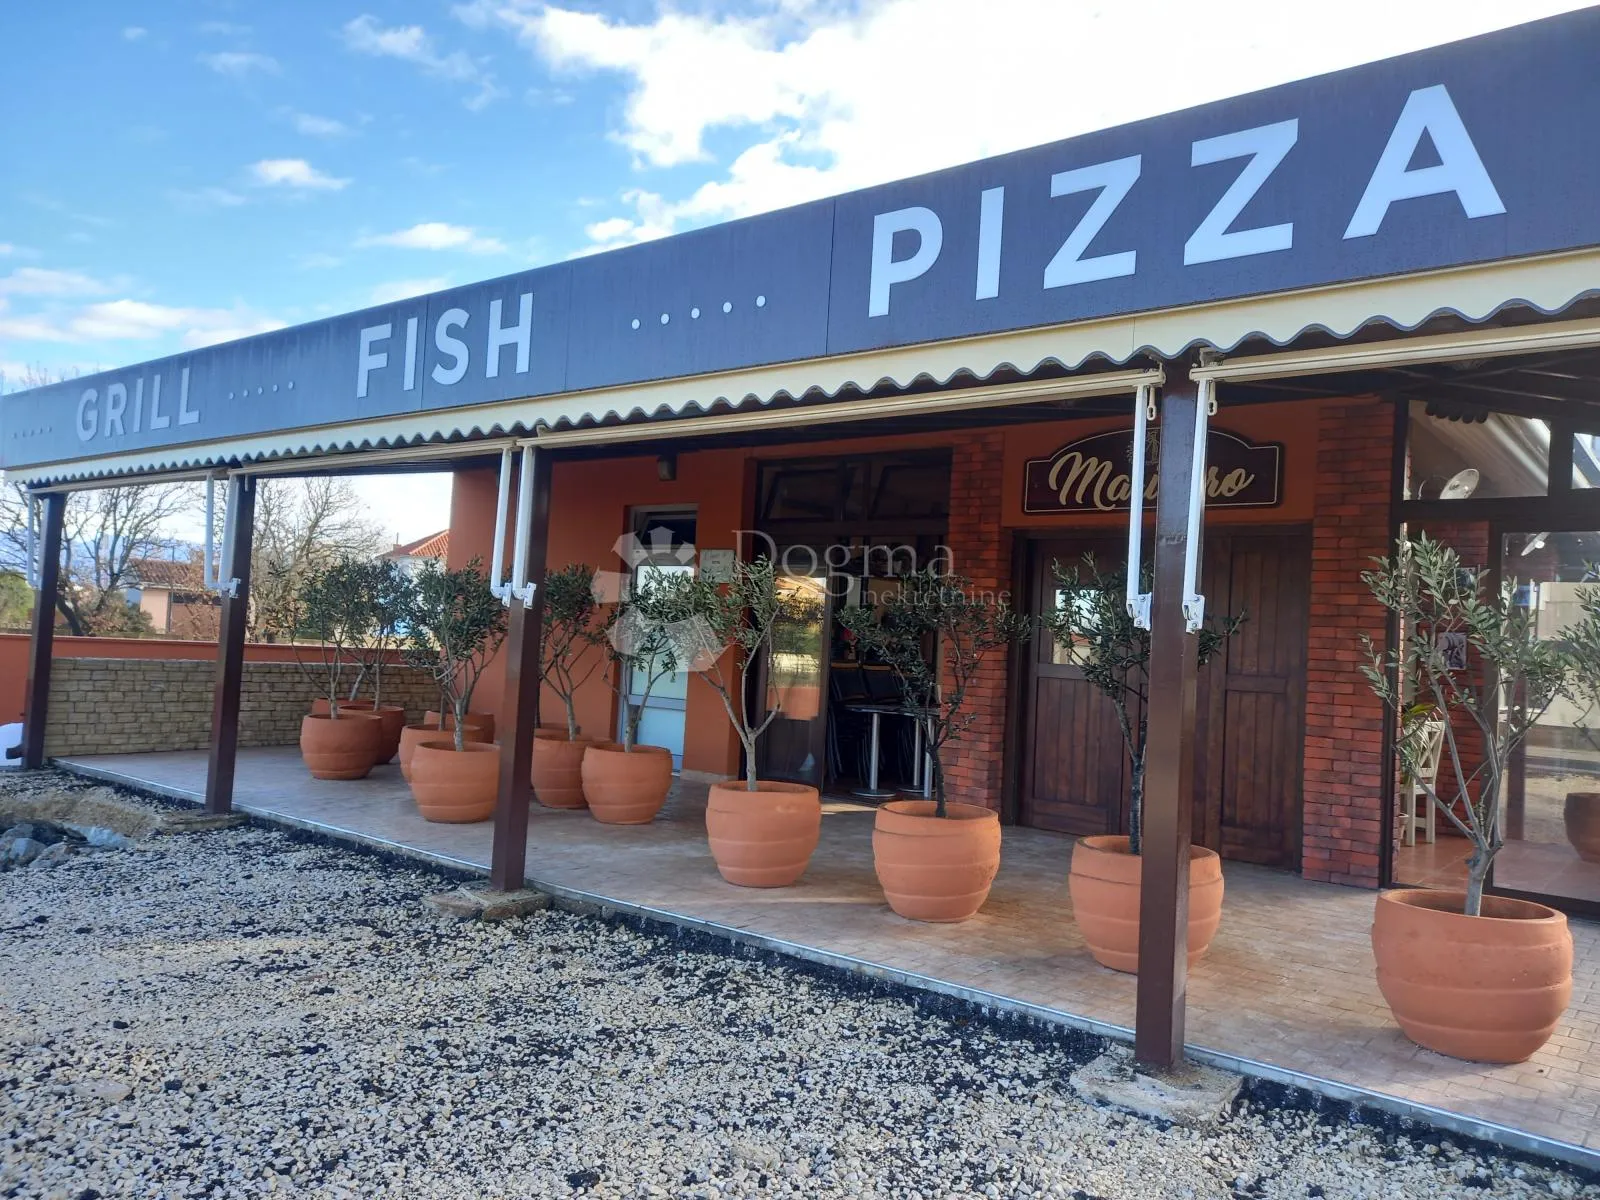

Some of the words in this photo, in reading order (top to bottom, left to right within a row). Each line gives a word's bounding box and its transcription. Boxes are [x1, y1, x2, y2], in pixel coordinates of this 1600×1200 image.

[76, 367, 201, 442] GRILL
[356, 292, 534, 399] FISH
[868, 83, 1507, 318] PIZZA
